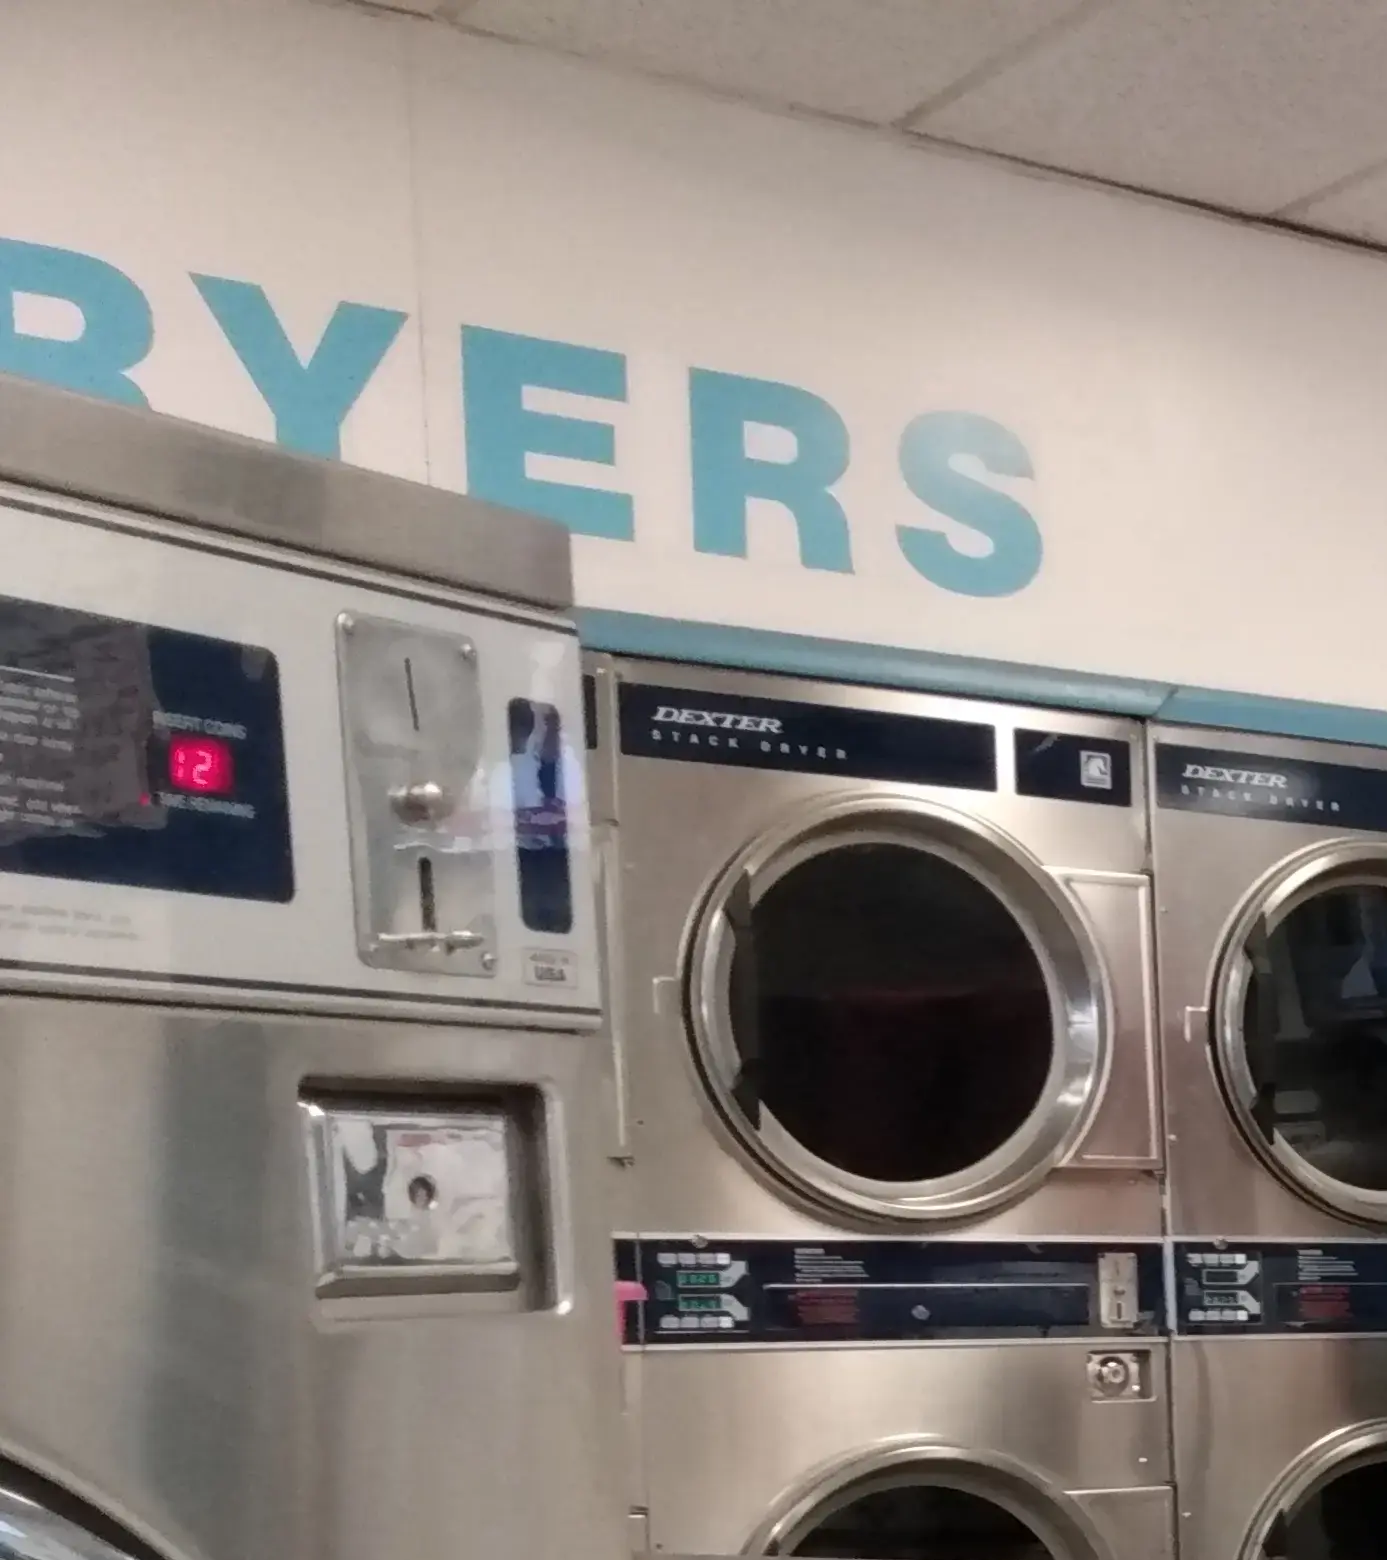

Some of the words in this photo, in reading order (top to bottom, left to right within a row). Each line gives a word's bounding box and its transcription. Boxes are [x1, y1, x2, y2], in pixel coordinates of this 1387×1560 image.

[650, 706, 785, 735] DEXTER
[651, 729, 739, 749] STACK
[1182, 764, 1288, 789] DEXTER
